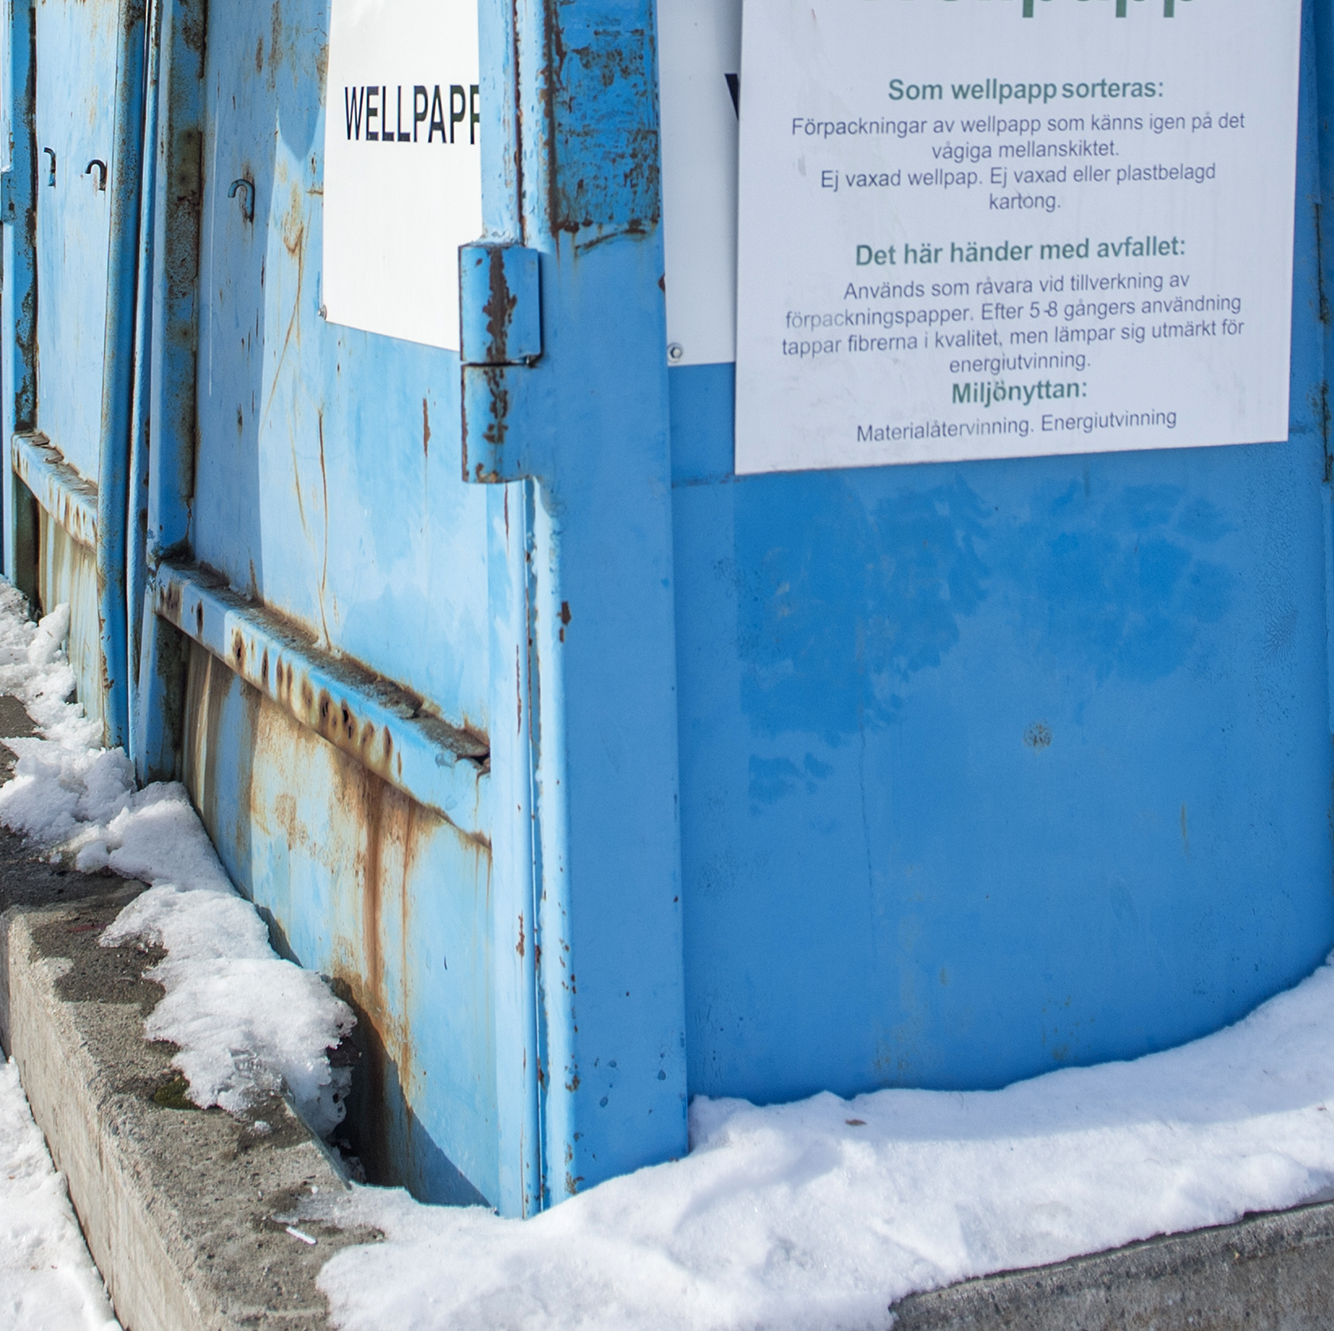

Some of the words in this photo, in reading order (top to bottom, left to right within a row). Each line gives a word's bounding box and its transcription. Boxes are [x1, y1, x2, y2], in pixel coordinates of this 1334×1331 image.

[888, 78, 943, 101] Som
[950, 78, 1058, 105] wellpapp
[1061, 78, 1164, 99] sorteras:
[791, 117, 928, 140] Förpackningar
[932, 119, 955, 134] av
[960, 115, 1042, 137] wellpapp
[1047, 117, 1085, 132] som
[1091, 113, 1144, 131] känns
[1149, 114, 1186, 135] igen
[1191, 112, 1213, 133] på
[1218, 112, 1245, 129] det
[931, 141, 992, 164] vågiga
[998, 139, 1119, 158] mellanskiktet.
[821, 169, 839, 193] Ej
[845, 169, 902, 188] vaxad
[907, 168, 983, 190] wellpap.
[990, 166, 1007, 189] Ej
[1013, 165, 1067, 184] vaxad
[1072, 165, 1112, 183] eller
[1116, 162, 1216, 186] plastbelagd
[989, 192, 1061, 213] kartong.
[856, 244, 897, 266] Det
[904, 242, 944, 265] här
[950, 240, 1034, 263] händer
[1040, 237, 1090, 260] med
[1096, 235, 1185, 258] avfallet:
[843, 280, 925, 300] Används
[931, 282, 970, 297] som
[976, 276, 1033, 295] råvara
[1039, 275, 1064, 293] vid
[1070, 273, 1164, 294] tillverkning
[1169, 273, 1190, 288] av
[785, 306, 973, 331] förpackningspapper.
[981, 302, 1024, 321] Efter
[1063, 298, 1136, 322] gångers
[1141, 295, 1242, 315] användning
[782, 337, 842, 359] tappar
[847, 334, 918, 353] fibrerna
[923, 332, 930, 349] i
[934, 328, 1003, 349] kvalitet,
[1010, 330, 1048, 345] men
[1054, 325, 1116, 346] lämpar
[1120, 324, 1146, 344] sig
[1151, 319, 1217, 339] utmärkt
[1221, 318, 1245, 336] för
[949, 352, 1090, 376] energiutvinning.
[952, 379, 1087, 408] Miljönyttan:
[857, 417, 1034, 443] Materialåtervinning.
[1041, 409, 1177, 434] Energiutvinning
